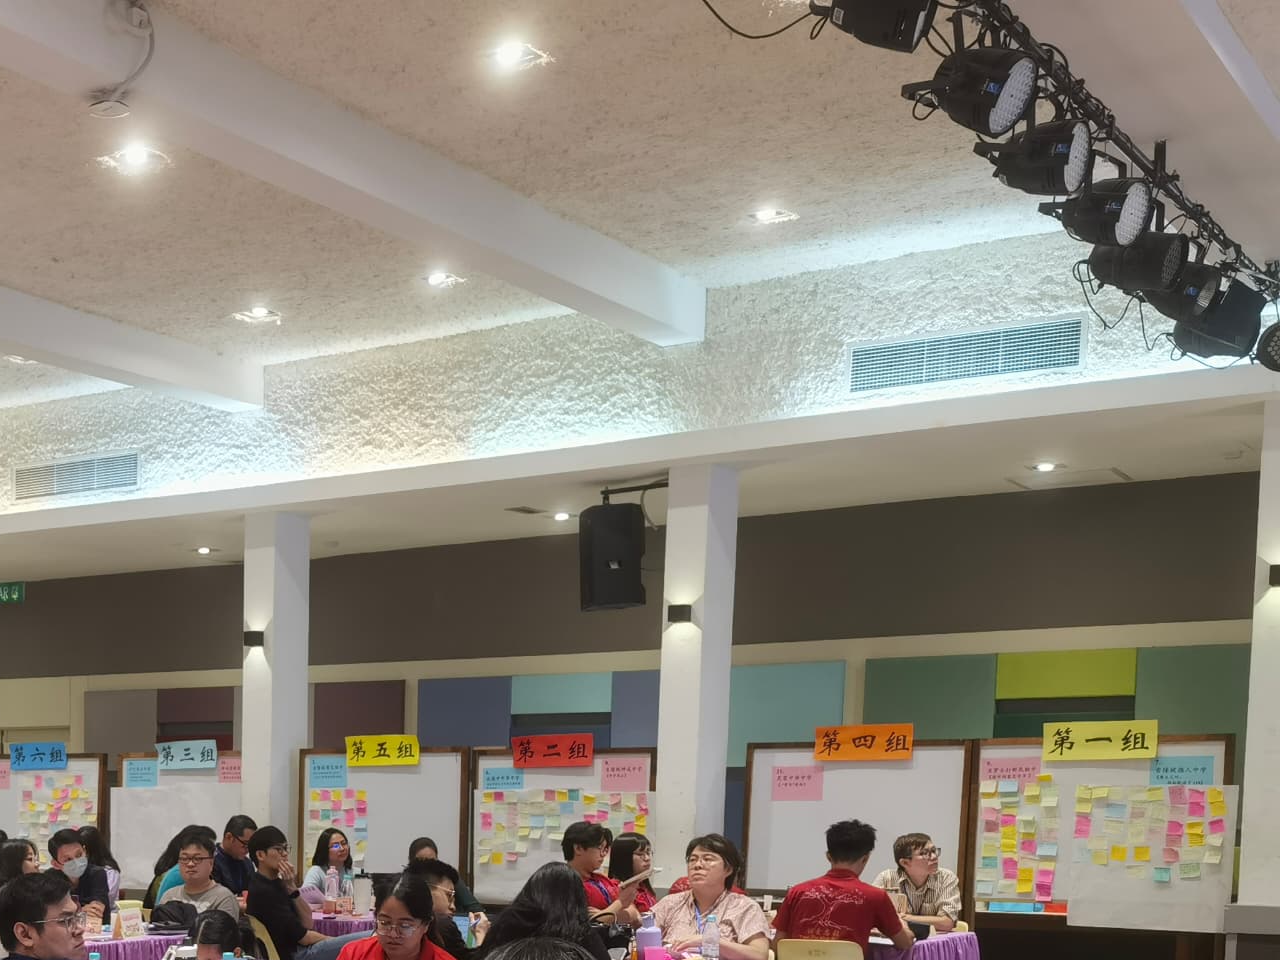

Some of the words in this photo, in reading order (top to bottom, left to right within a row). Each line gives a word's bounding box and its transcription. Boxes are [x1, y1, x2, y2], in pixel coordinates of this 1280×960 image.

[350, 739, 415, 762] 第五组
[517, 739, 588, 763] 第二组
[817, 730, 910, 756] 第四组
[1048, 727, 1149, 756] 第一组
[13, 745, 64, 766] 第六组
[160, 745, 215, 766] 第三组
